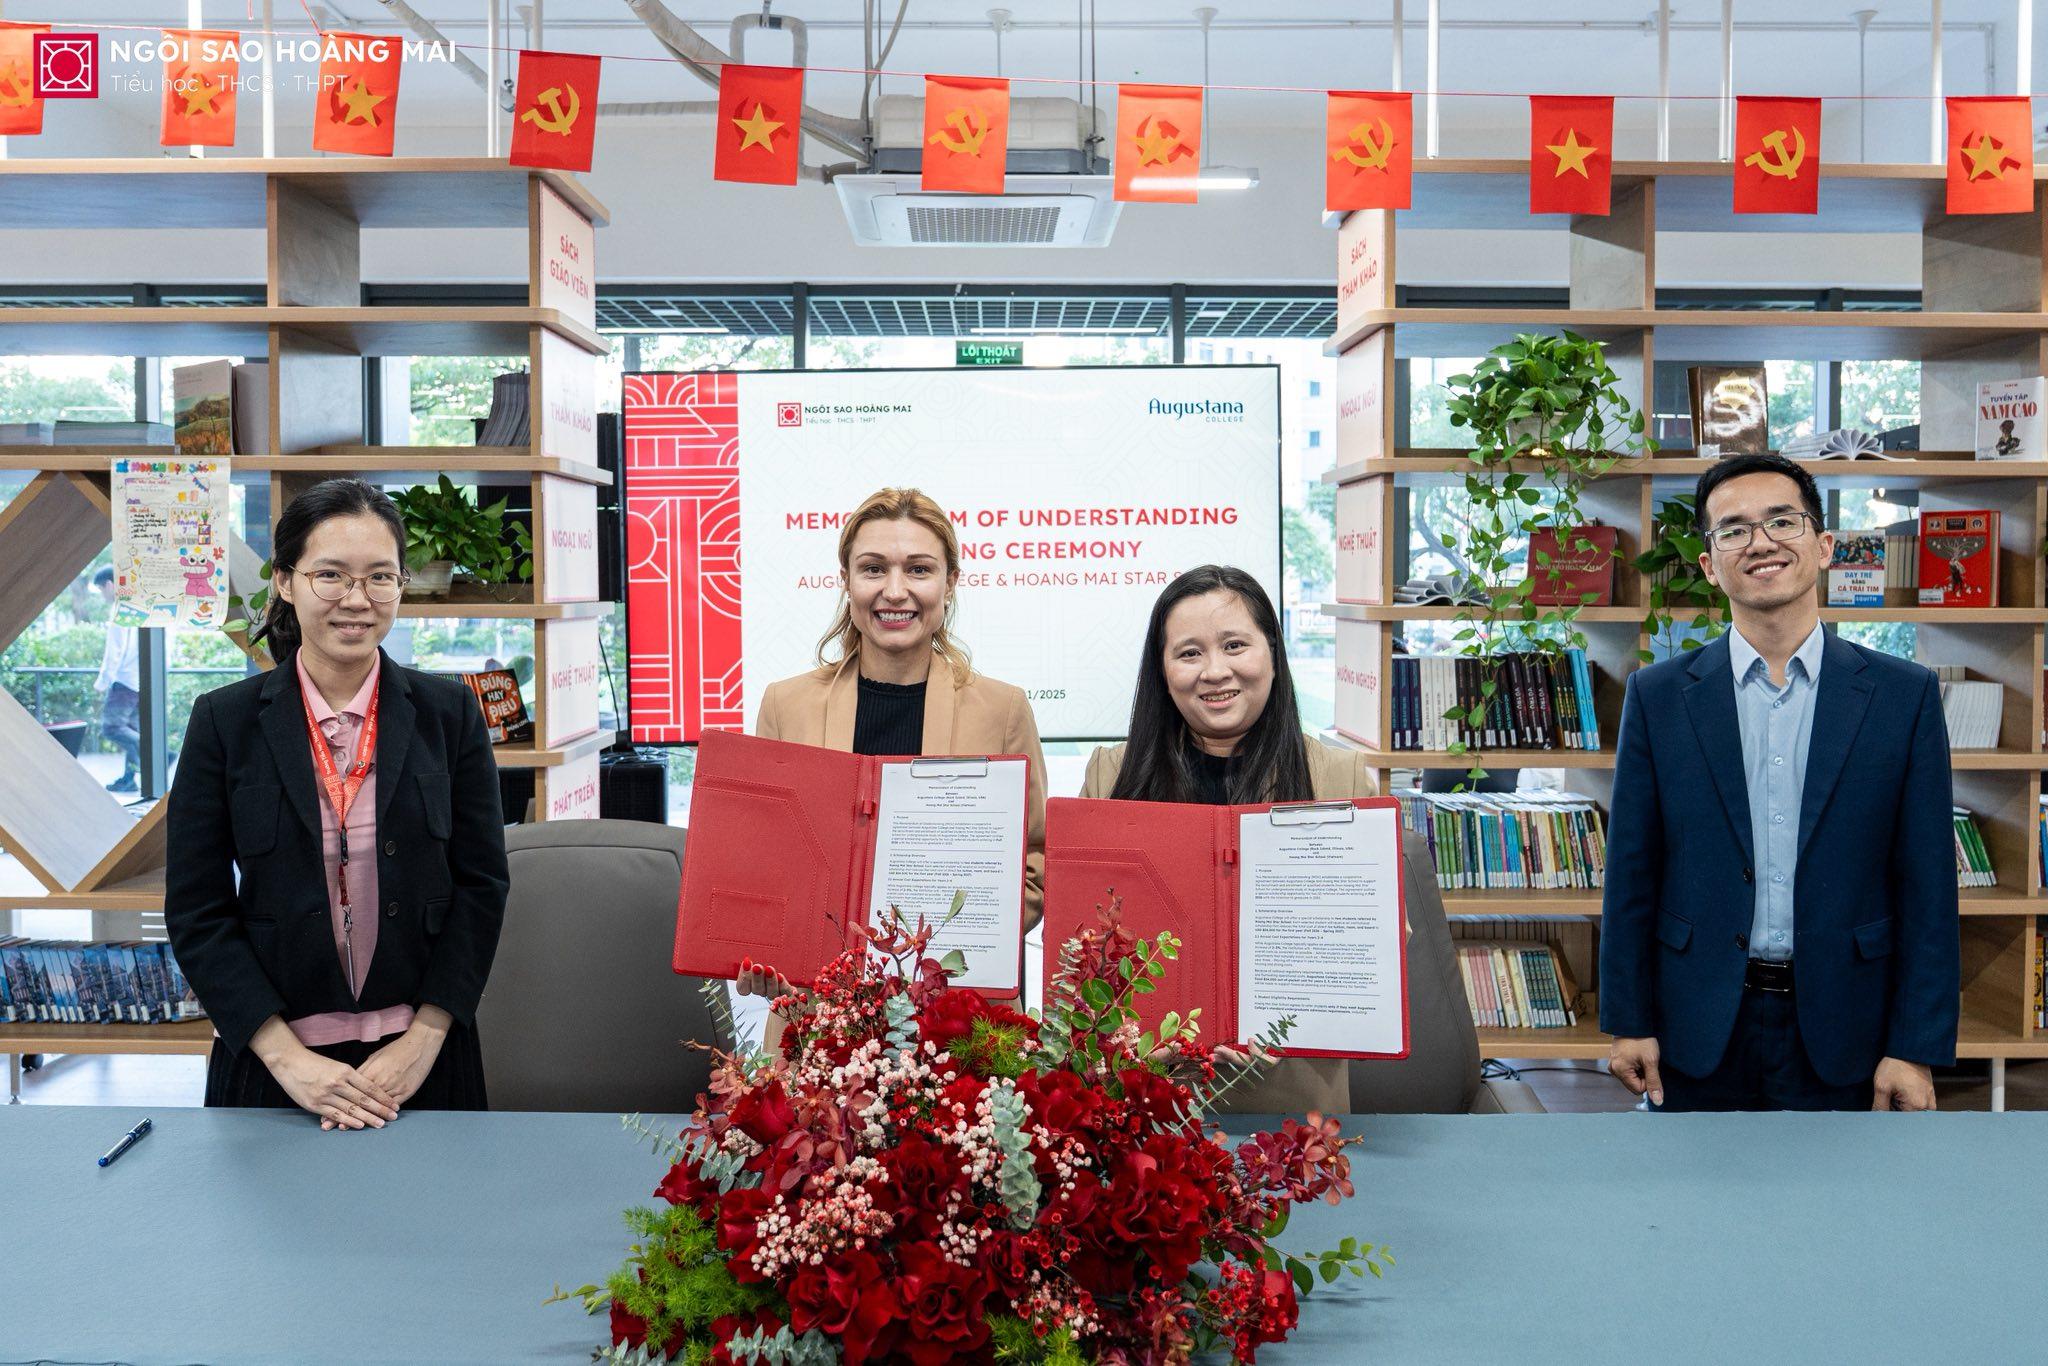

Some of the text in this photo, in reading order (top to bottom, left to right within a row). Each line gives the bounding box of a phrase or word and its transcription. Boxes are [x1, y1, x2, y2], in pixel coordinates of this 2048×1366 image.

[560, 234, 578, 264] SÁCH
[1352, 238, 1366, 264] SÁCH
[550, 258, 588, 300] GIÁO VIÊN
[1342, 275, 1358, 302] THAM
[804, 404, 830, 414] NGÔI
[856, 404, 890, 413] HOÀNG
[1149, 398, 1243, 420] Augustana
[1981, 402, 2037, 420] NAM CAO
[977, 510, 1009, 527] OF
[1019, 508, 1238, 527] UNDERSTANDING
[552, 530, 576, 553] NGOẠI
[1006, 541, 1143, 559] CEREMONY
[997, 574, 1008, 586] &
[1014, 572, 1081, 586] HOANG
[1085, 572, 1117, 586] MAI
[1121, 572, 1167, 585] STAR
[481, 673, 512, 691] ĐÚNG
[552, 666, 572, 691] NGHỆ
[487, 690, 504, 702] HAY
[1028, 690, 1066, 700] 1/2025
